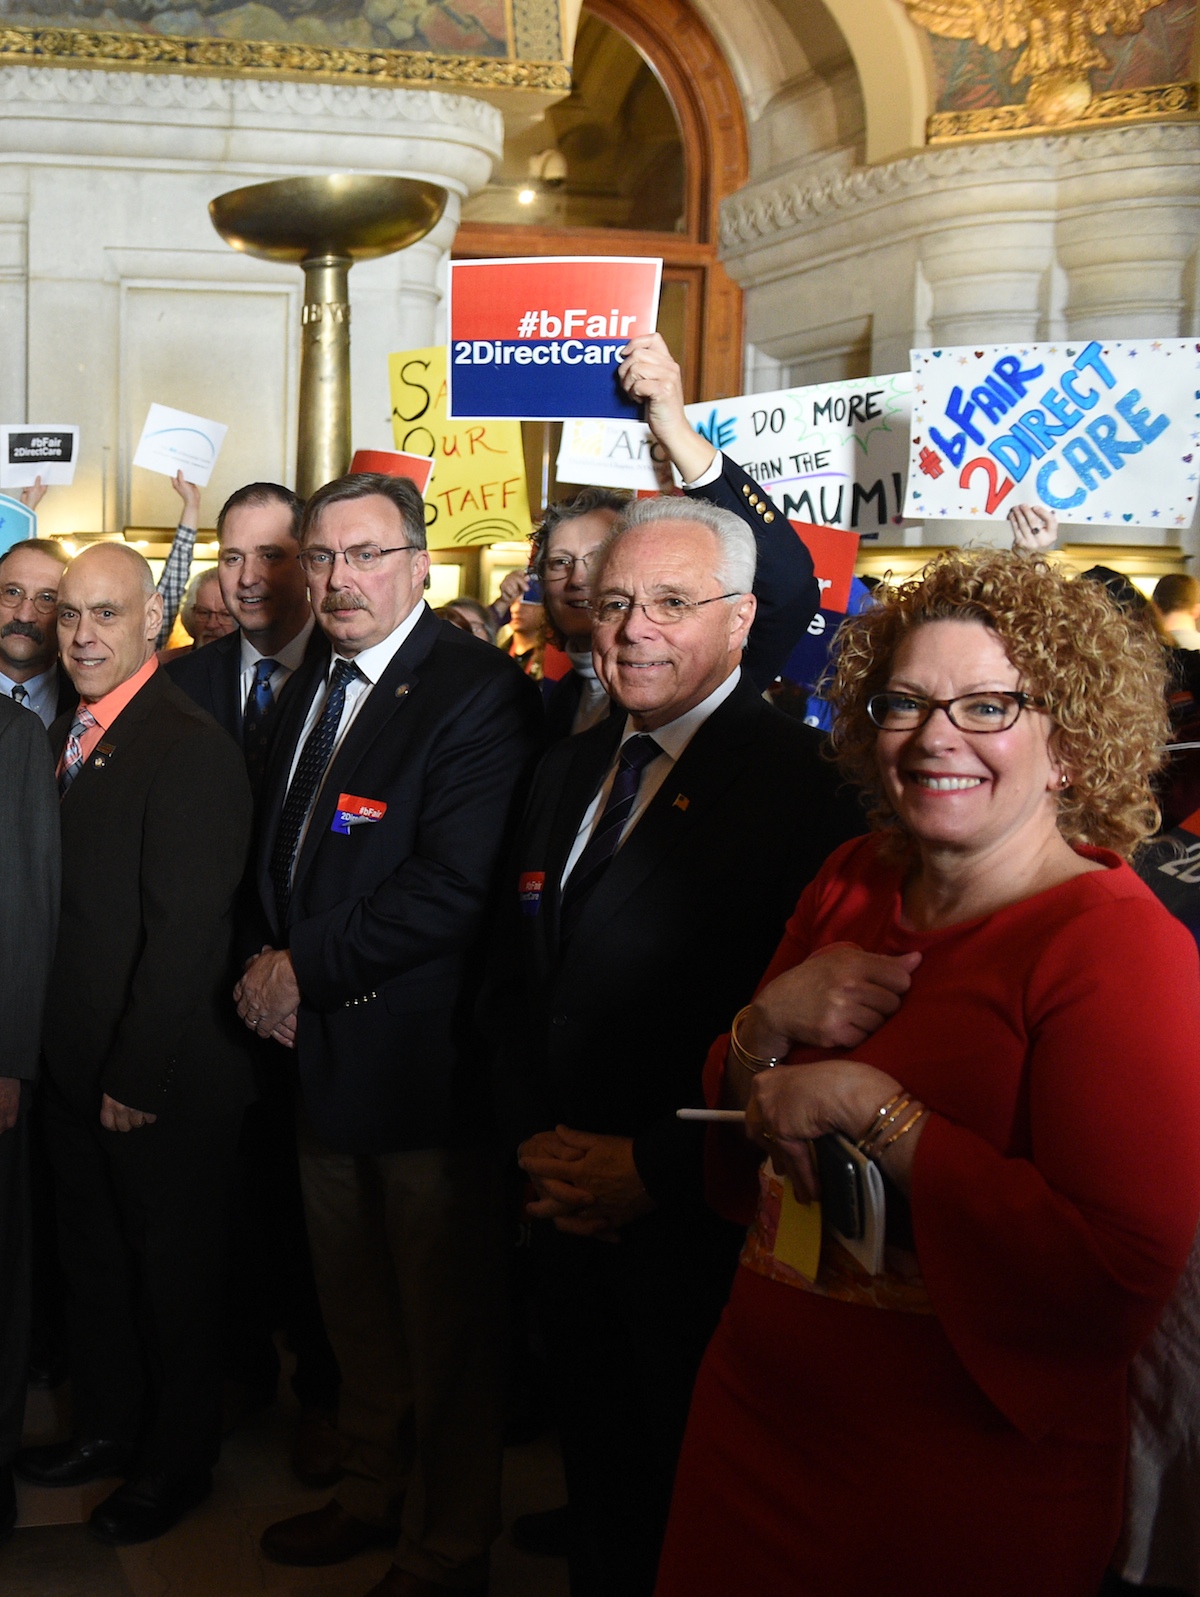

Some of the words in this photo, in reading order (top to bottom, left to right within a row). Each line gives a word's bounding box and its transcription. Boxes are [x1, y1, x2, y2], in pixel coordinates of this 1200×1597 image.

[516, 309, 637, 338] #bFair
[751, 407, 786, 437] DO
[813, 390, 885, 428] MORE
[402, 426, 509, 458] OUR
[1036, 388, 1171, 510] CARE
[789, 449, 832, 474] THE
